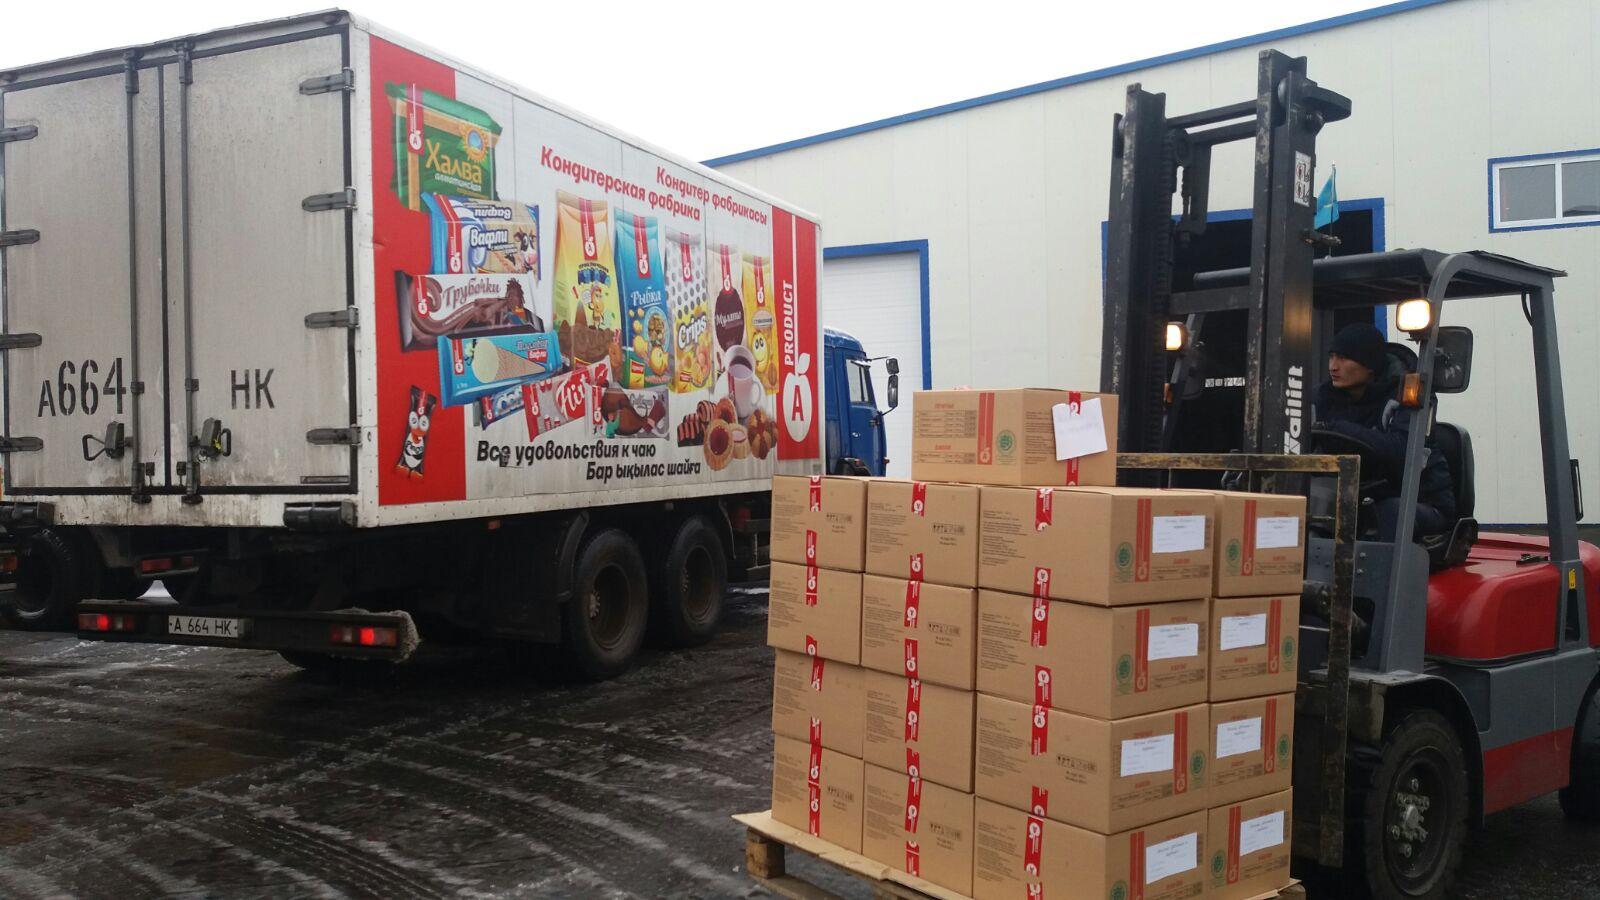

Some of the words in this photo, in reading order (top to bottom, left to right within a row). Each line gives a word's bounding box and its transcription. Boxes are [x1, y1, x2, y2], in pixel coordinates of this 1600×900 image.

[425, 138, 482, 185] Халва
[540, 145, 646, 201] Кондитерская
[649, 191, 701, 222] фабрика
[656, 166, 710, 203] Кондитер
[712, 193, 767, 225] фабрикасы
[442, 277, 500, 309] Трубочки
[631, 286, 662, 307] Рыбка
[678, 314, 707, 350] Crips
[782, 280, 794, 367] PRODUCT
[37, 357, 127, 418] A664
[230, 368, 277, 411] HK
[791, 384, 805, 422] A
[476, 440, 511, 462] Все
[515, 440, 620, 467] удовольствия
[622, 444, 631, 459] к
[632, 443, 656, 458] чаю
[586, 461, 612, 484] Бар
[616, 462, 665, 480] ықылас
[667, 459, 702, 476] шайға
[174, 617, 182, 632] A
[188, 618, 209, 634] 664
[214, 620, 232, 635] HK
